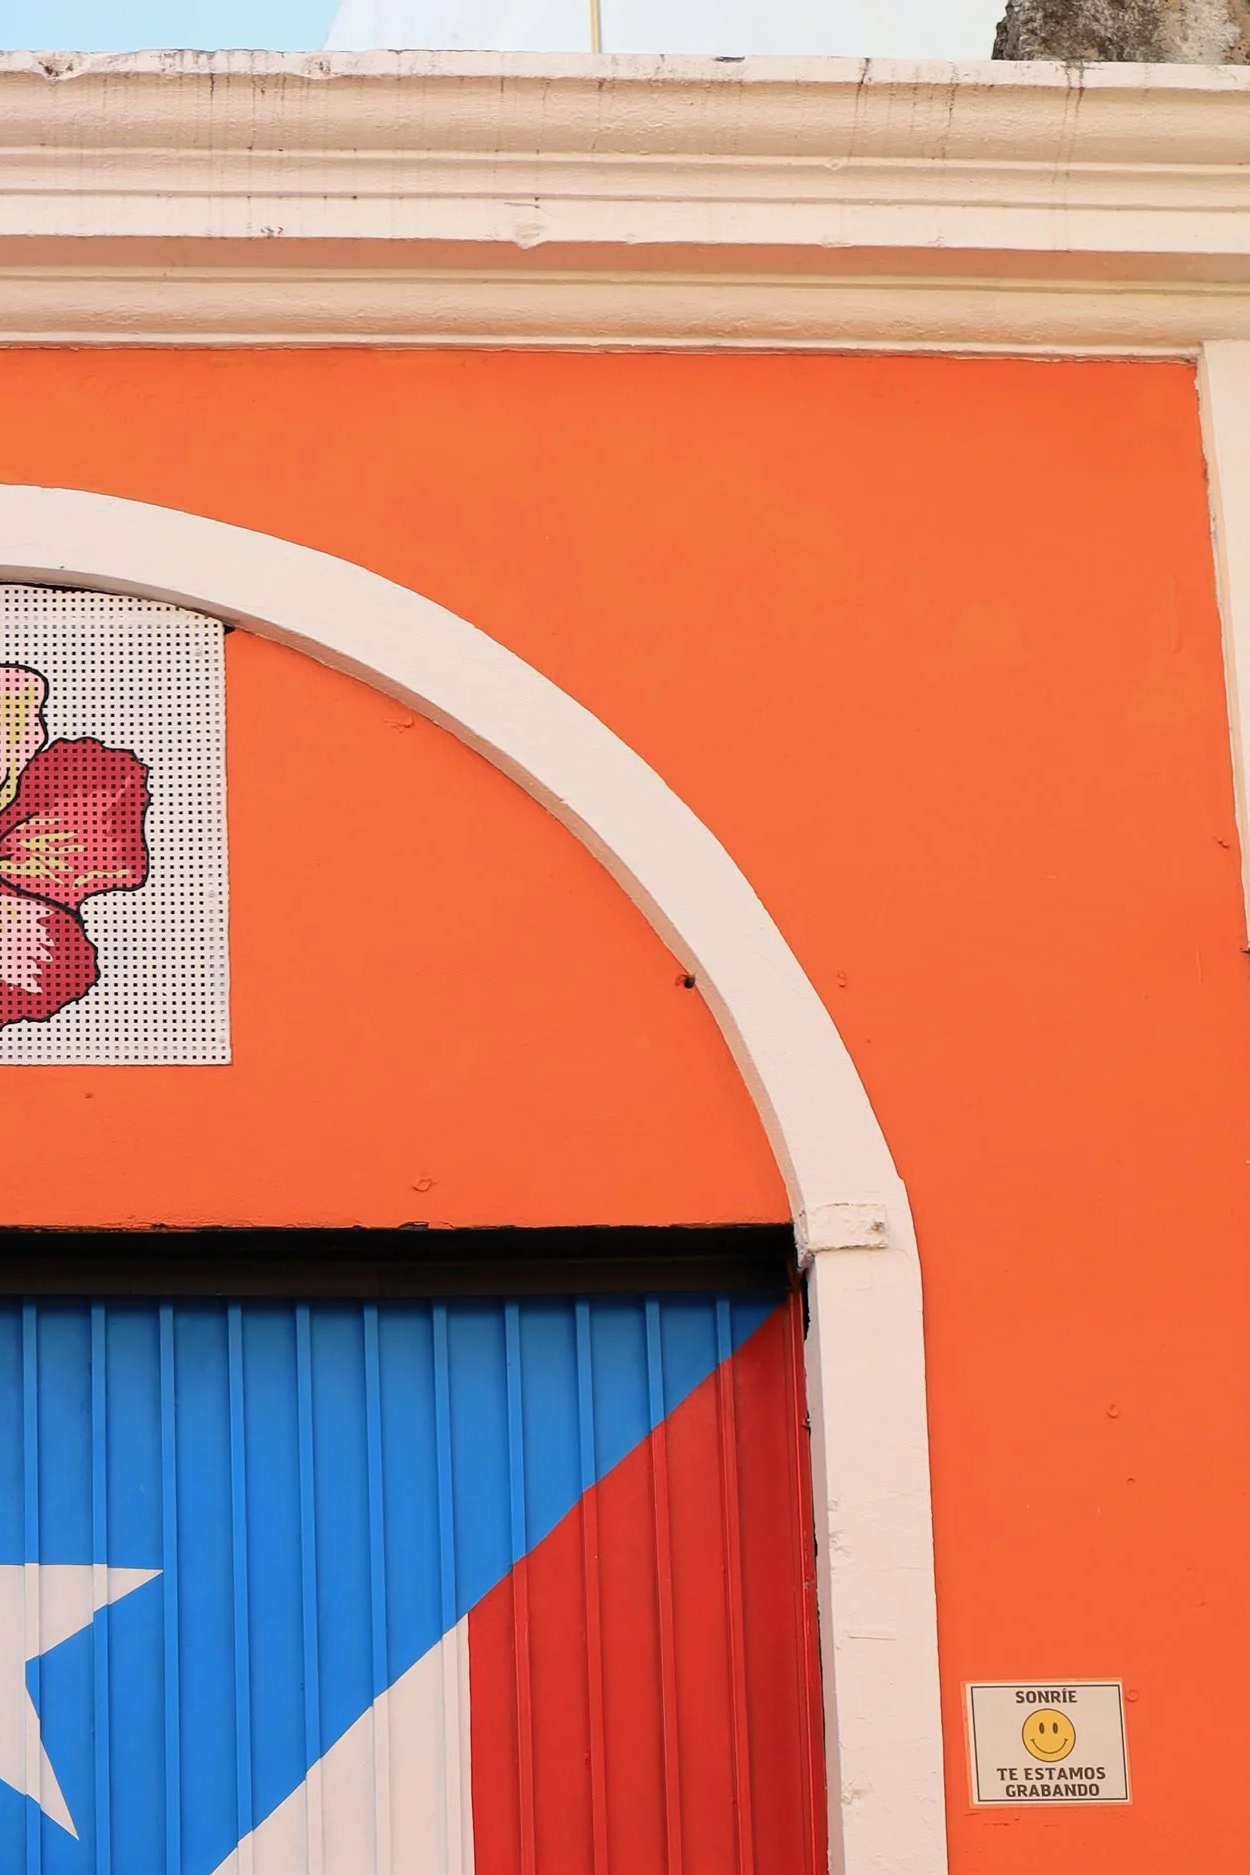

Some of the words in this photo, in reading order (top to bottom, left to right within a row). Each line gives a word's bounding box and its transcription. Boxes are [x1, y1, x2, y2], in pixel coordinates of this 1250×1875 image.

[1015, 1688, 1078, 1704] SONRÍE
[996, 1768, 1018, 1781] TE
[1024, 1767, 1106, 1781] ESTAMOS
[1005, 1783, 1100, 1798] GRABANDO
